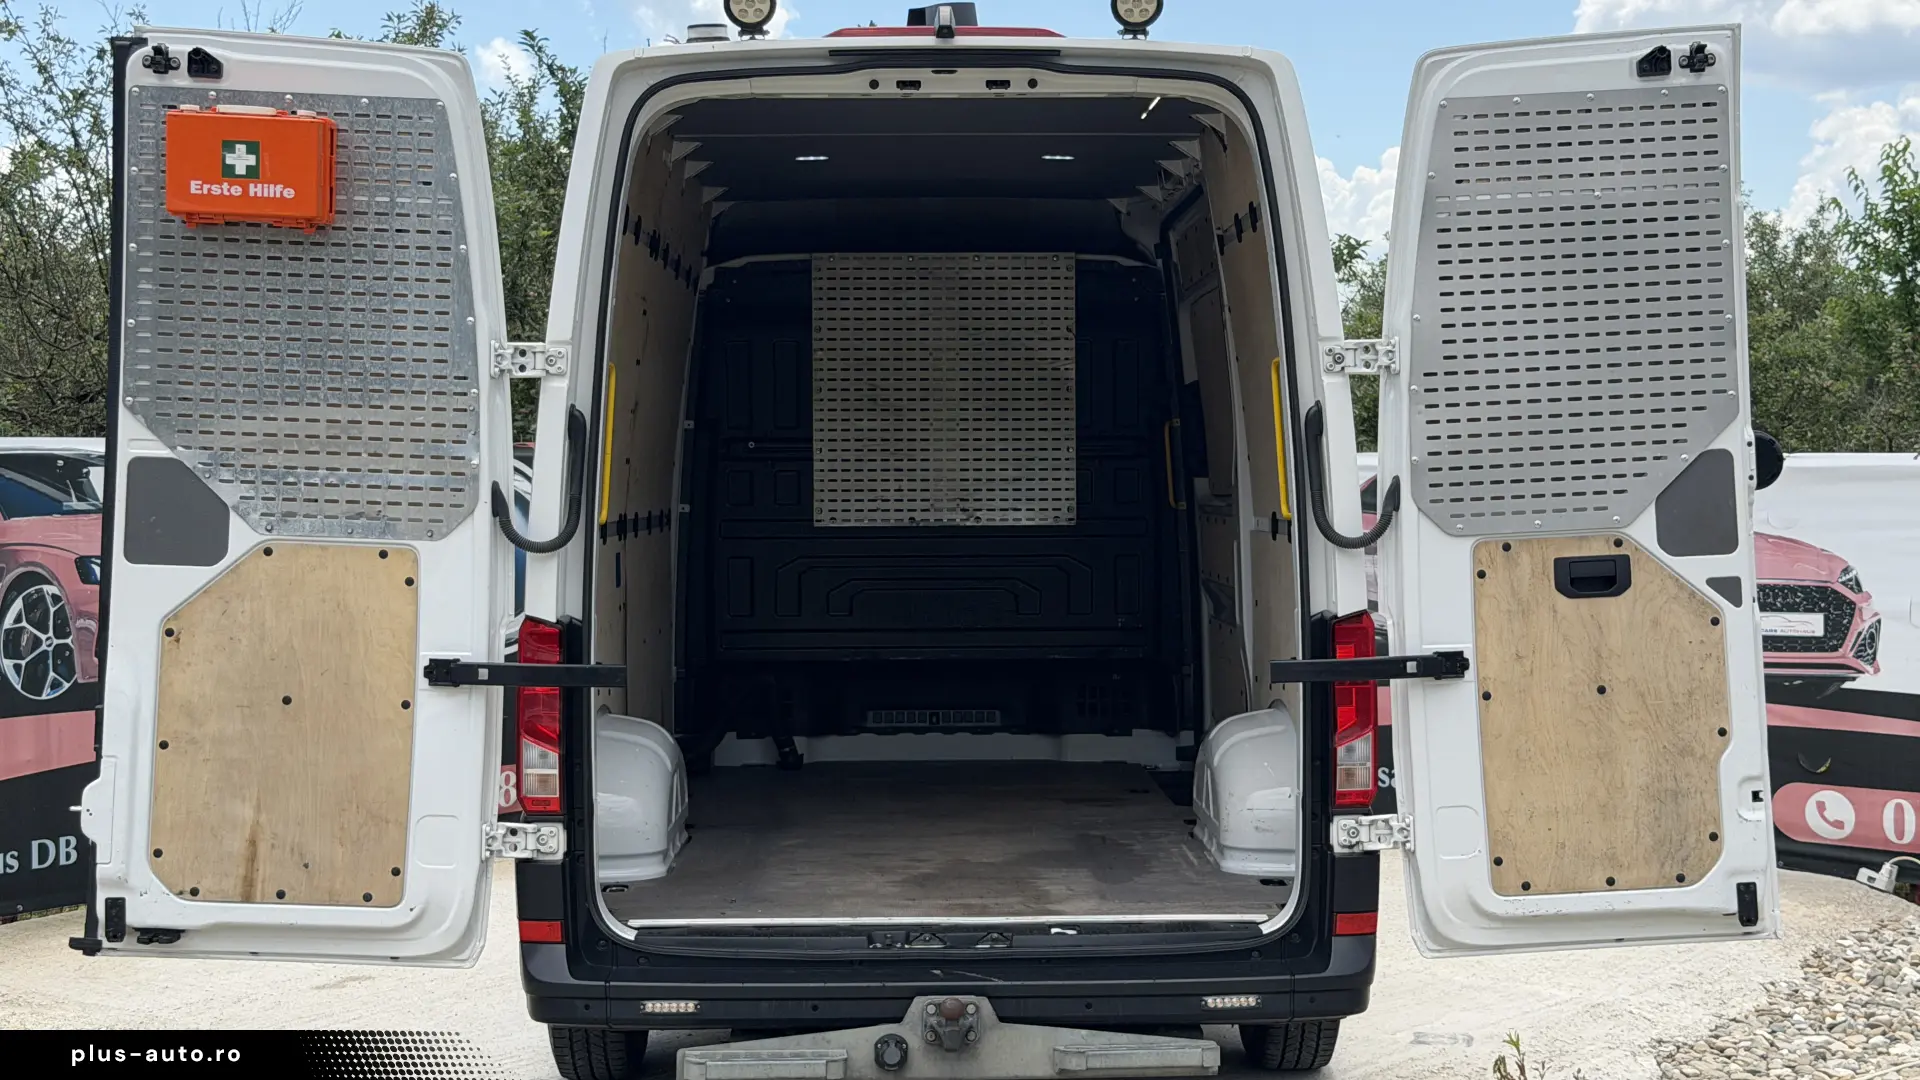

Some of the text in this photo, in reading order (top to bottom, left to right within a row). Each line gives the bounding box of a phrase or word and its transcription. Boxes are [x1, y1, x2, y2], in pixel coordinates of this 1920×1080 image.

[190, 180, 295, 198] Erste Hilfe
[1882, 798, 1916, 845] 0
[31, 835, 78, 870] DB
